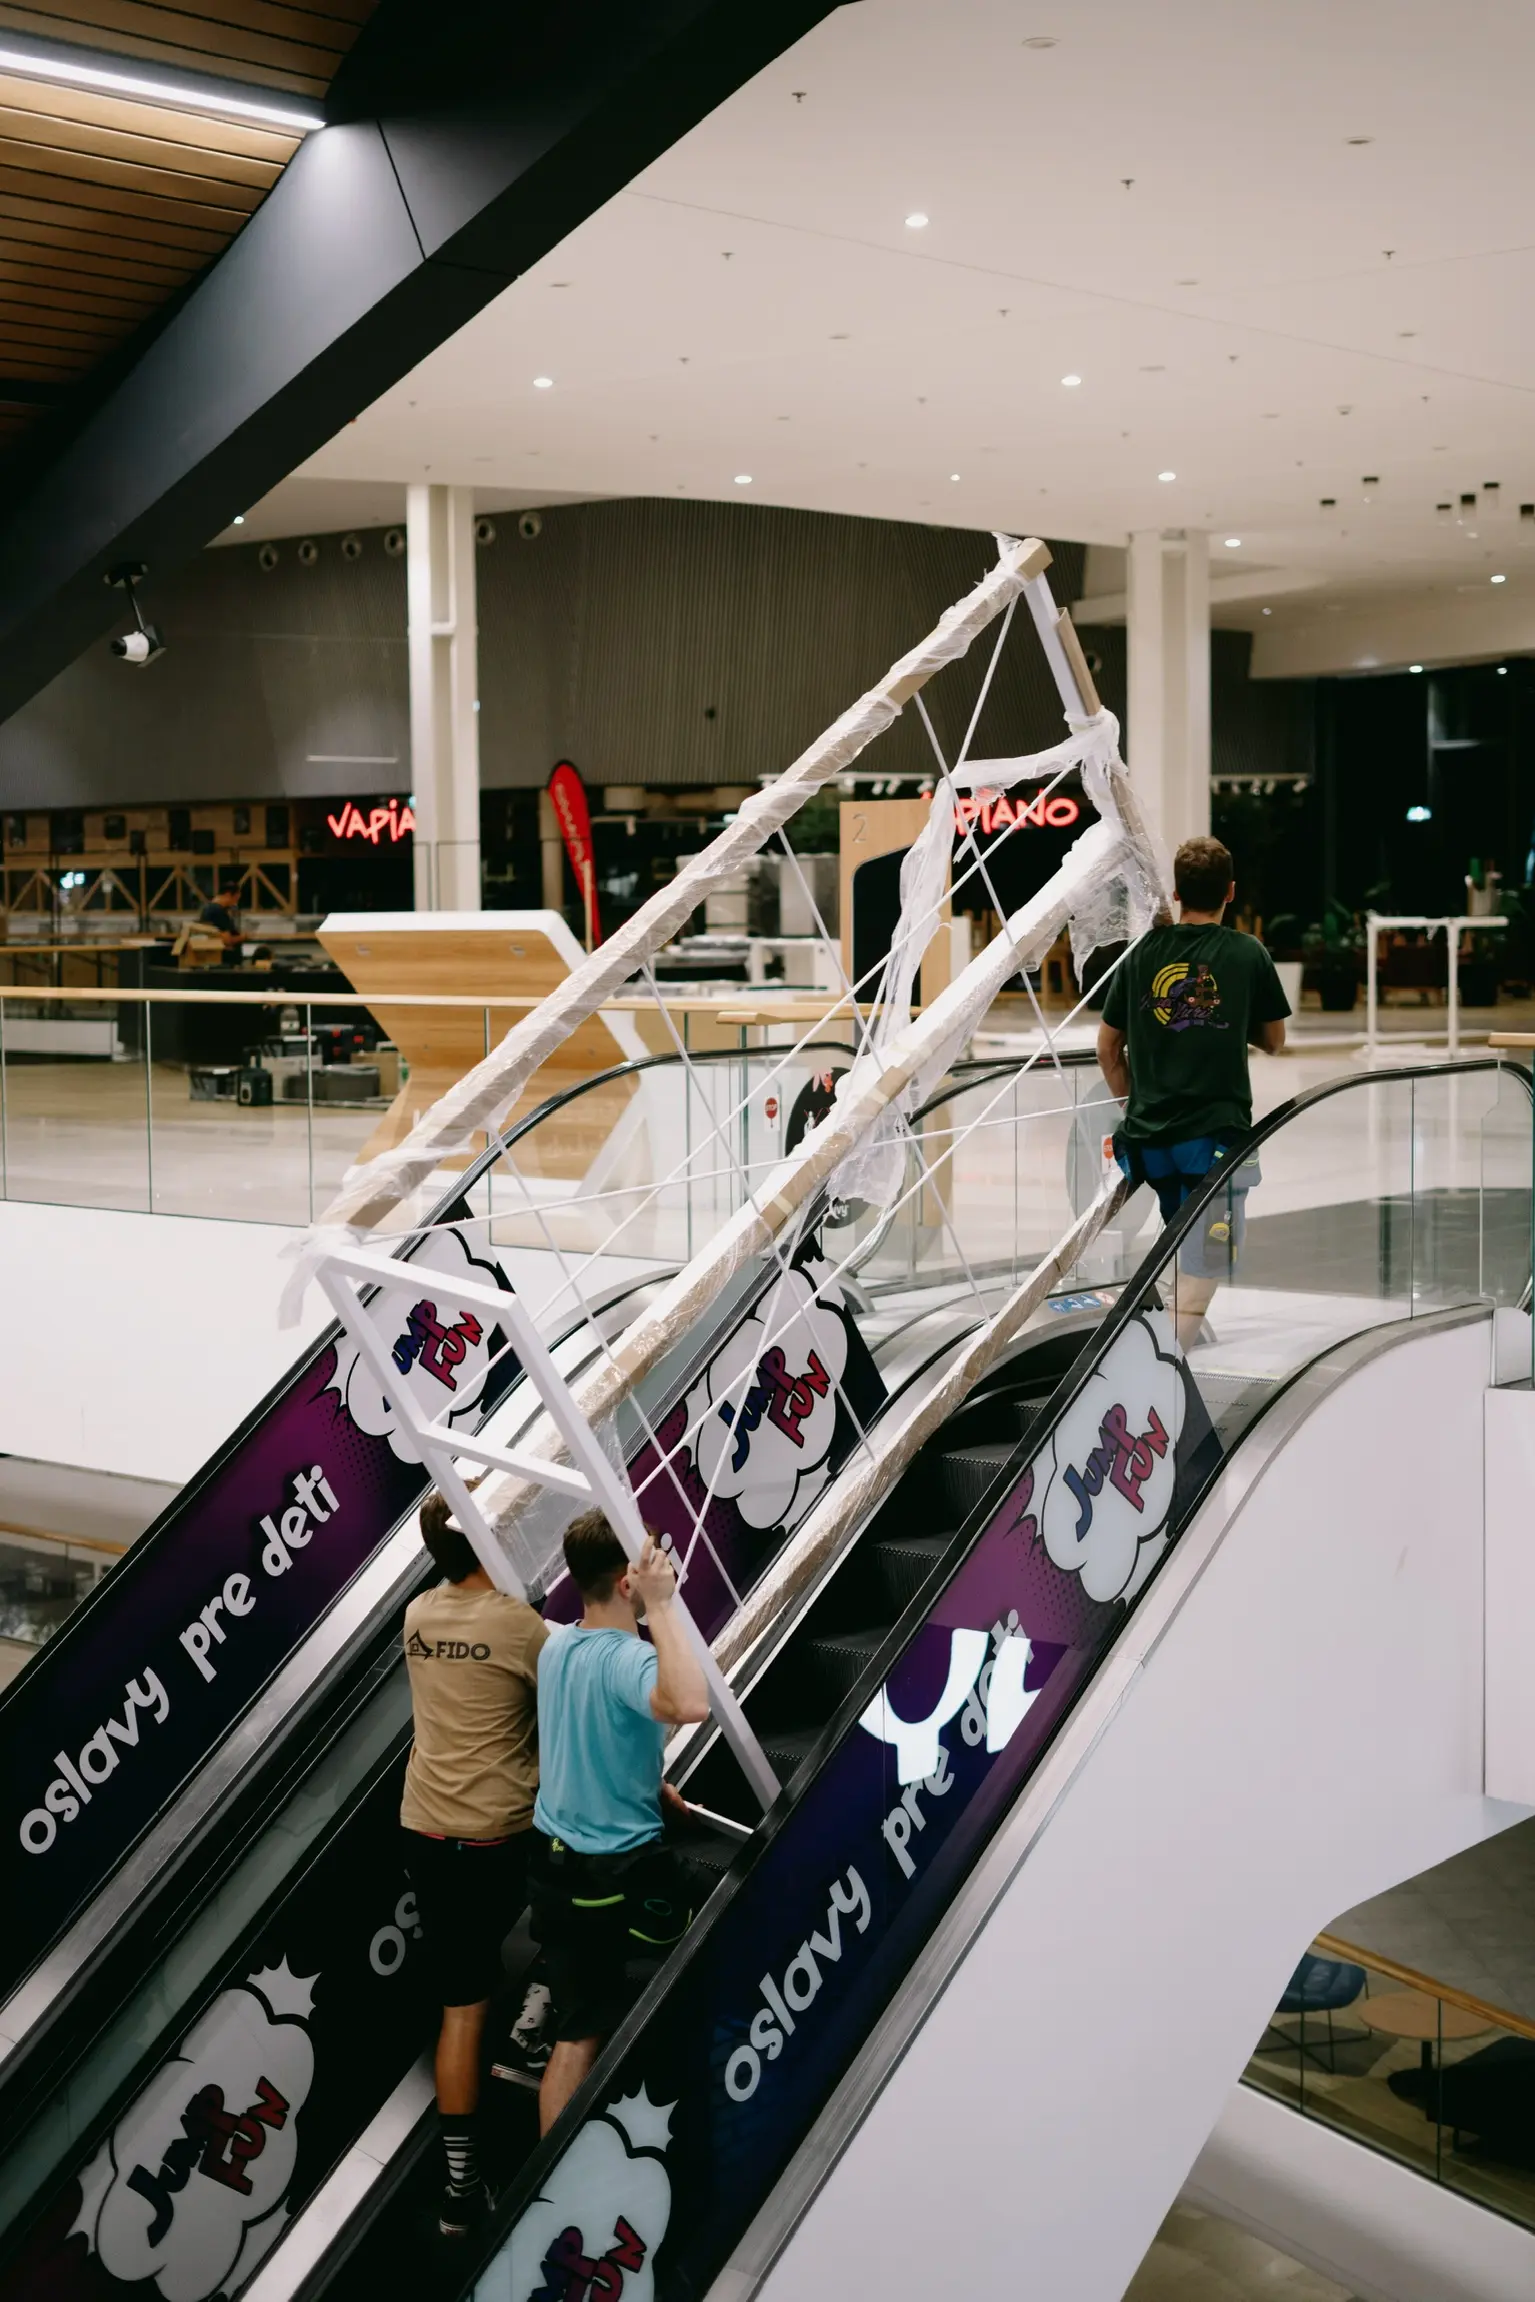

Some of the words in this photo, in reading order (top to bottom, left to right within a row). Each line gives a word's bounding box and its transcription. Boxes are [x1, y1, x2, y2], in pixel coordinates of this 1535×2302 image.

[852, 813, 867, 843] 2
[385, 1299, 447, 1400] UMP
[418, 1310, 484, 1392] FUN
[767, 1349, 831, 1449] FUN
[718, 1346, 796, 1474] JUMP
[1110, 1405, 1170, 1514] FUN
[1063, 1403, 1137, 1543] JUMP
[19, 1666, 170, 1854] oslavy
[179, 1573, 256, 1683] pre
[261, 1465, 340, 1577] deti
[436, 1641, 491, 1661] FIDO
[724, 1865, 871, 2102] oslavy
[881, 1745, 955, 1880] pre
[126, 2083, 241, 2249] JUMP
[198, 2075, 290, 2197] FUN
